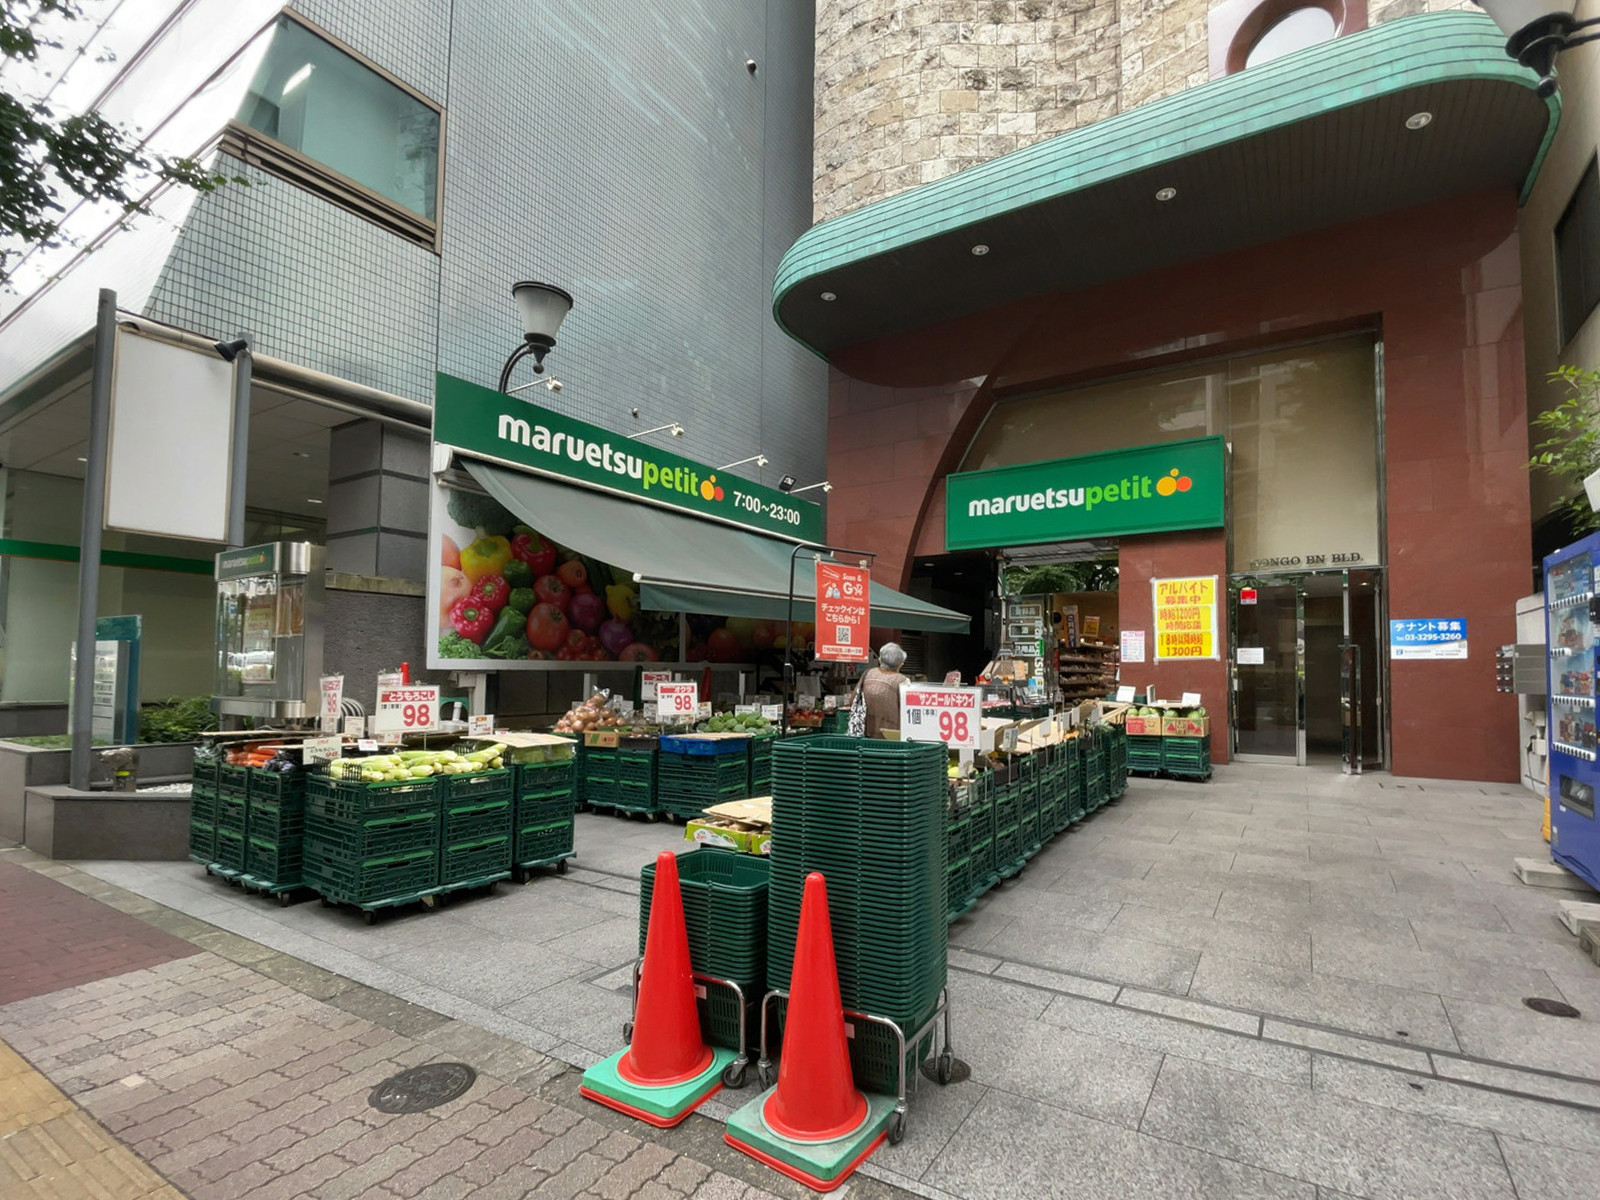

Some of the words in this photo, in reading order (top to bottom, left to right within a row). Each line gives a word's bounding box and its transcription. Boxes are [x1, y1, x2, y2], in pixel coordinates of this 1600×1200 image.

[1306, 554, 1326, 565] BN
[1331, 552, 1364, 563] BLD.
[1159, 582, 1209, 595] アルバイト
[1165, 595, 1201, 604] 募集中
[821, 602, 866, 616] チェックインは
[1395, 621, 1461, 632] テナント募集
[1166, 646, 1203, 656] 1300円
[388, 690, 436, 702] とうもろこし
[918, 693, 975, 707] サンゴールドキウイ
[674, 695, 692, 711] 98
[402, 703, 431, 727] 98
[939, 710, 969, 742] 98
